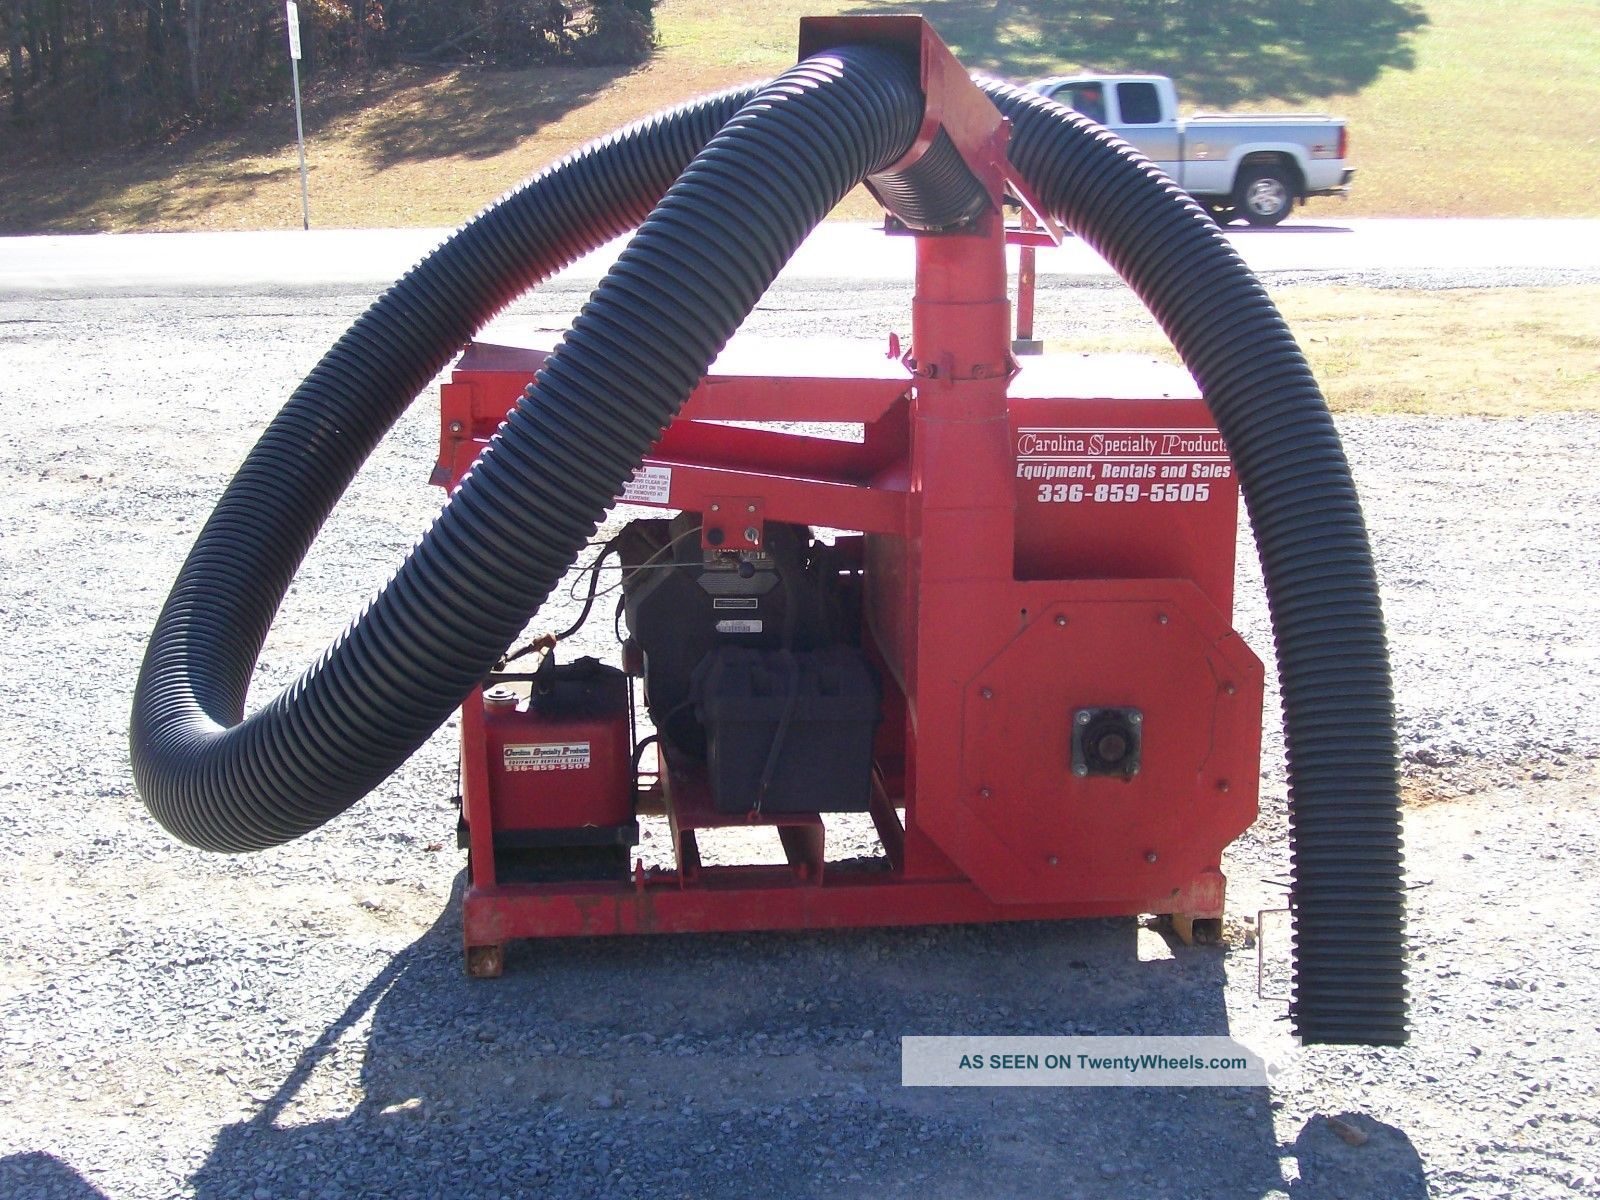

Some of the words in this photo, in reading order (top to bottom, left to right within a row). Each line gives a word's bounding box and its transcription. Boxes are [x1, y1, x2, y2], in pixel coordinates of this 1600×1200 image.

[1017, 433, 1084, 455] Carolina
[1087, 434, 1158, 455] Specialty
[1016, 463, 1096, 480] Equipment,
[1101, 463, 1156, 478] Rentals
[1160, 463, 1187, 478] and
[1191, 463, 1232, 478] Sales
[1037, 483, 1210, 502] 336-859-5505
